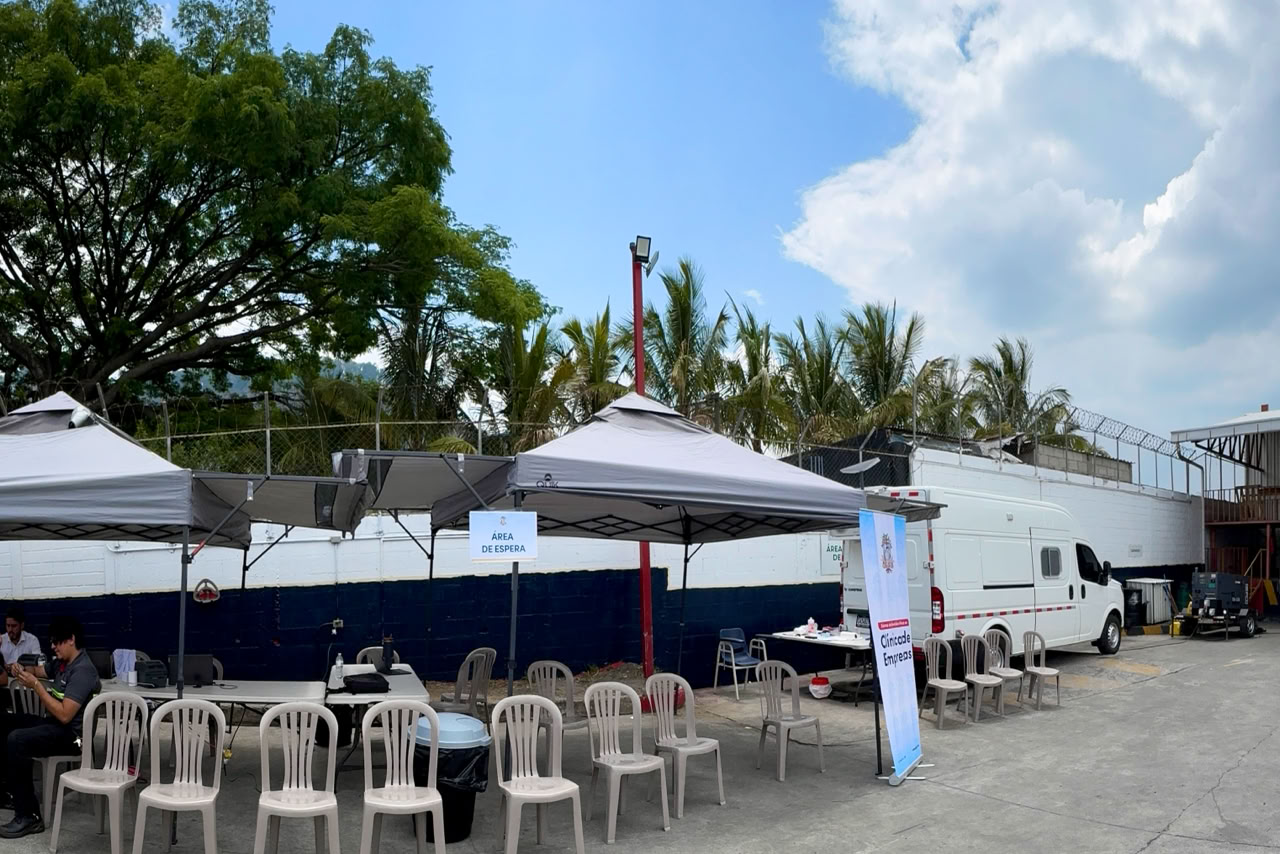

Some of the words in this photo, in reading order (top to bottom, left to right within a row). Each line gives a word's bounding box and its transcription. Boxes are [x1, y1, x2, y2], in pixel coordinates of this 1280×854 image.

[491, 530, 514, 541] ÁREA
[482, 544, 493, 553] DE
[494, 544, 526, 553] ESPERA
